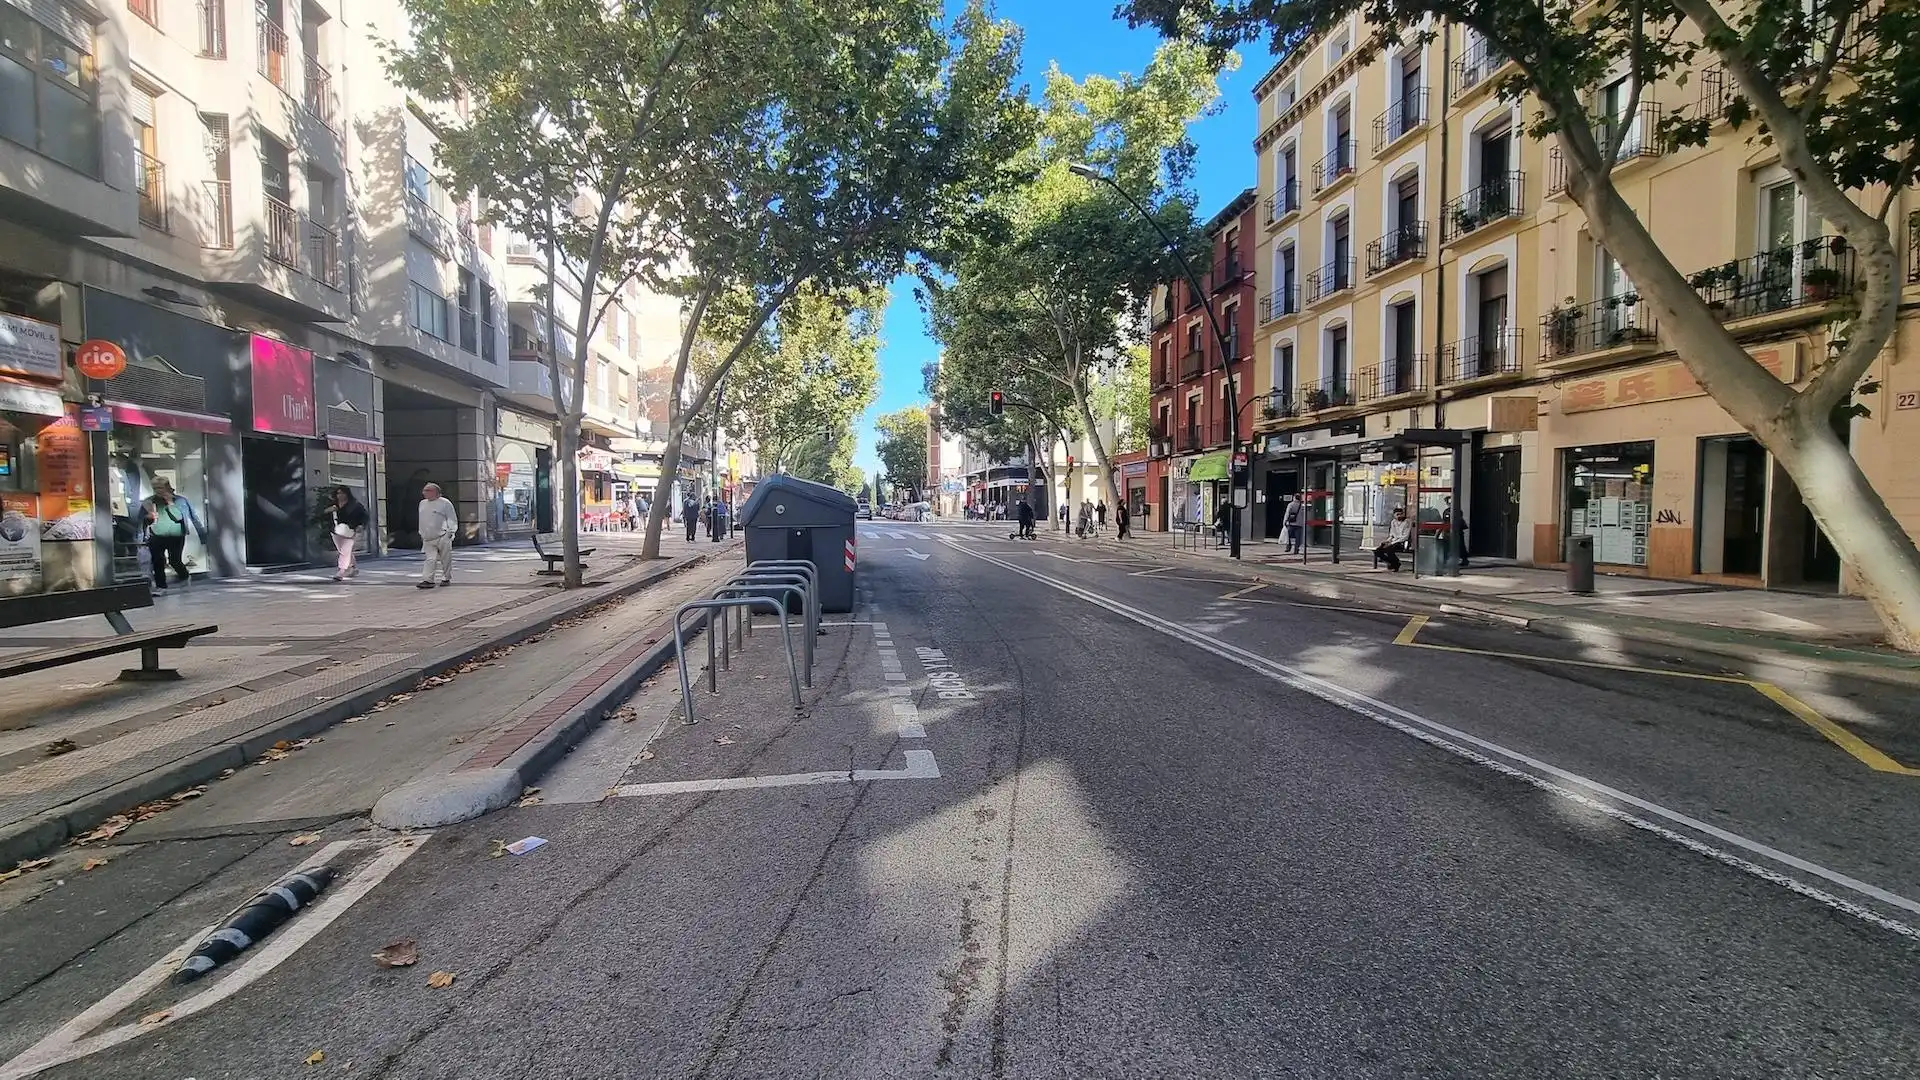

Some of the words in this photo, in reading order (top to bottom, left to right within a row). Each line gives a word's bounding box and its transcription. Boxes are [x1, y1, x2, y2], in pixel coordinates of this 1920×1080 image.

[82, 345, 115, 365] ria
[1899, 394, 1915, 407] 22
[927, 671, 976, 699] BICIS
